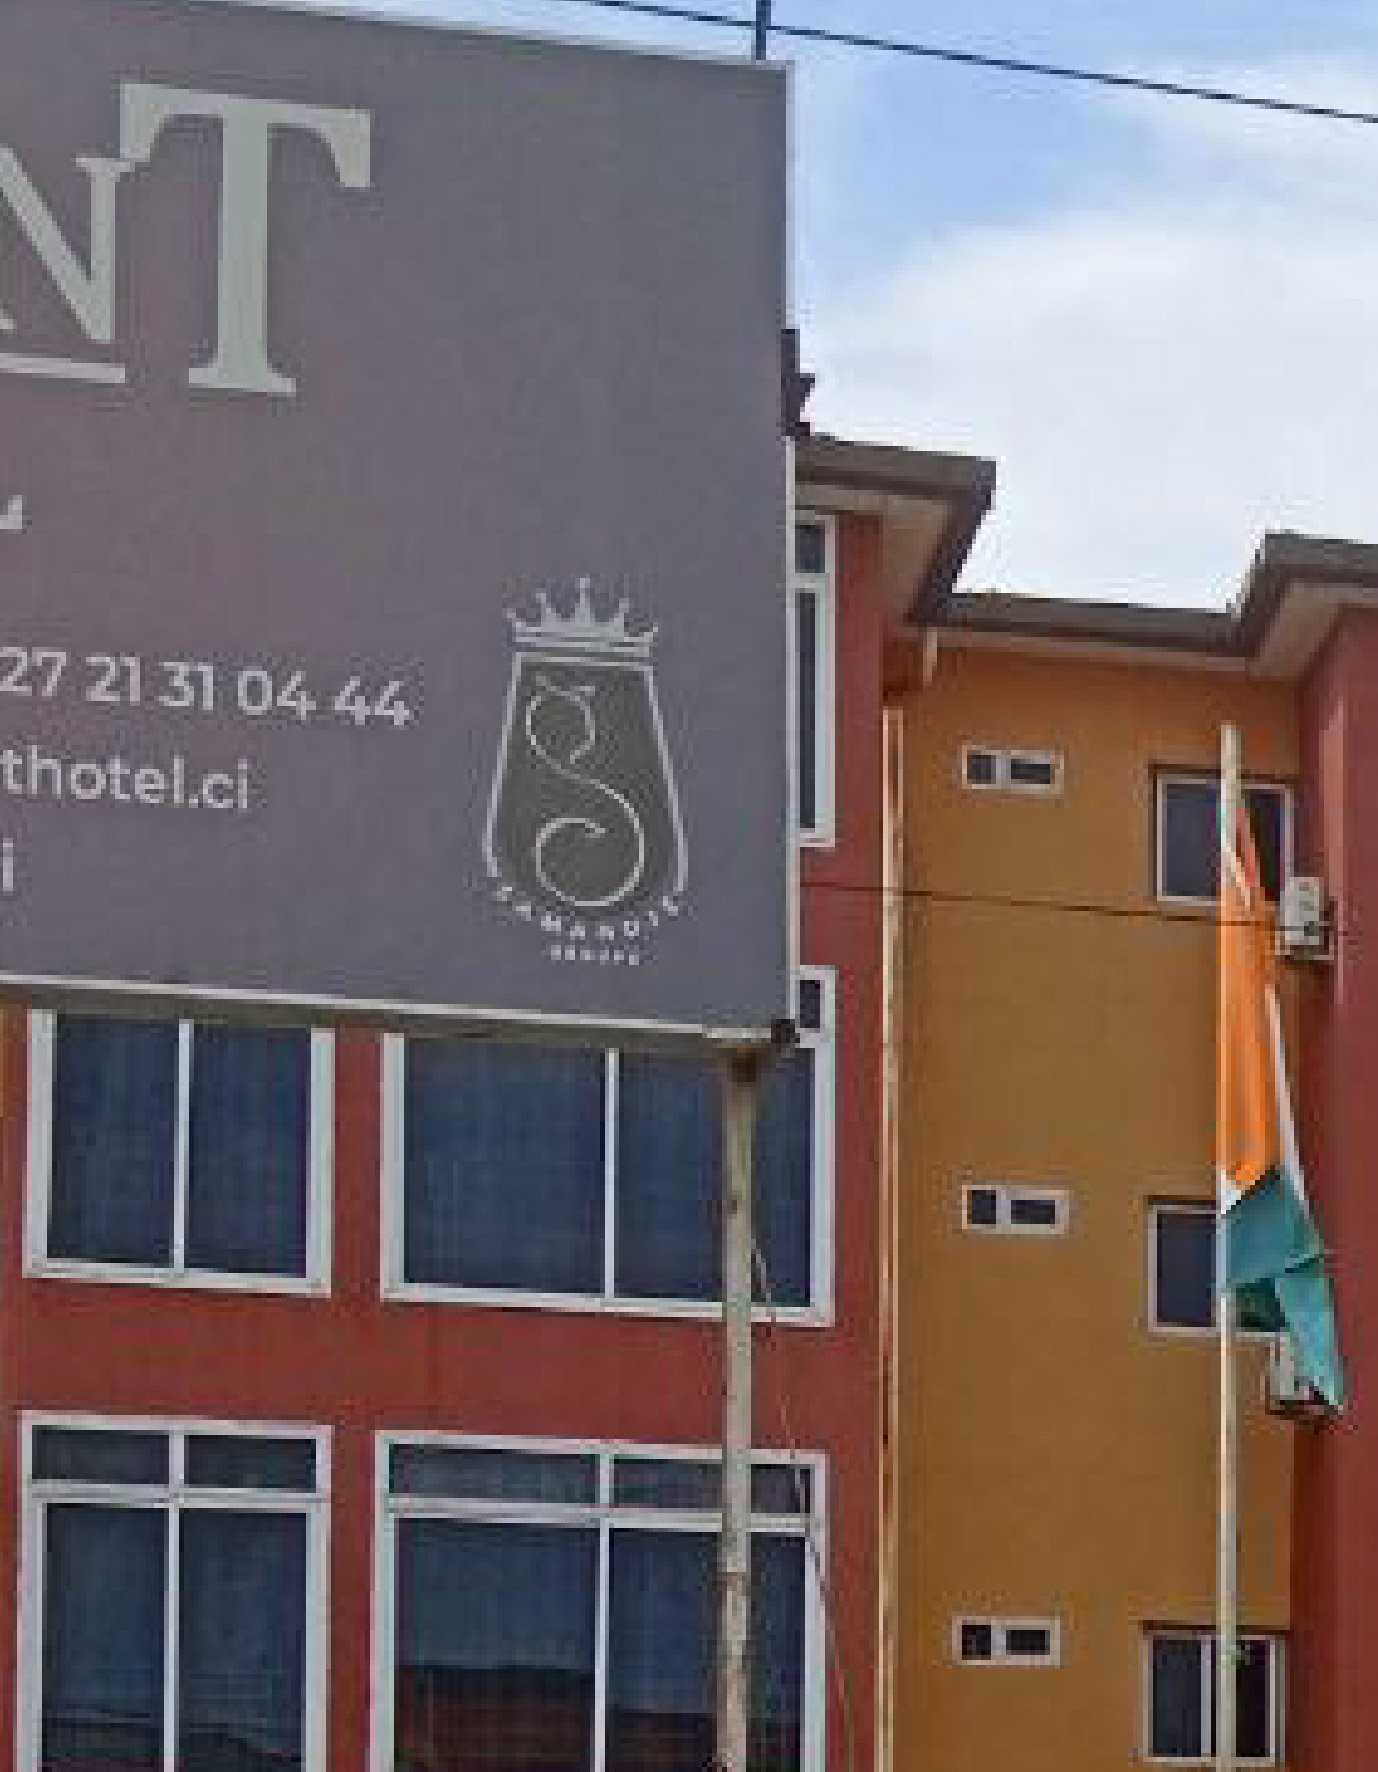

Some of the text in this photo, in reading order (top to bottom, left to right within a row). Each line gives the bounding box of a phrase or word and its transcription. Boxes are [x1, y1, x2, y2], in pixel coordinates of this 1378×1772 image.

[0, 646, 410, 725] 27 21 31 04 44
[2, 744, 248, 814] thotel.ci
